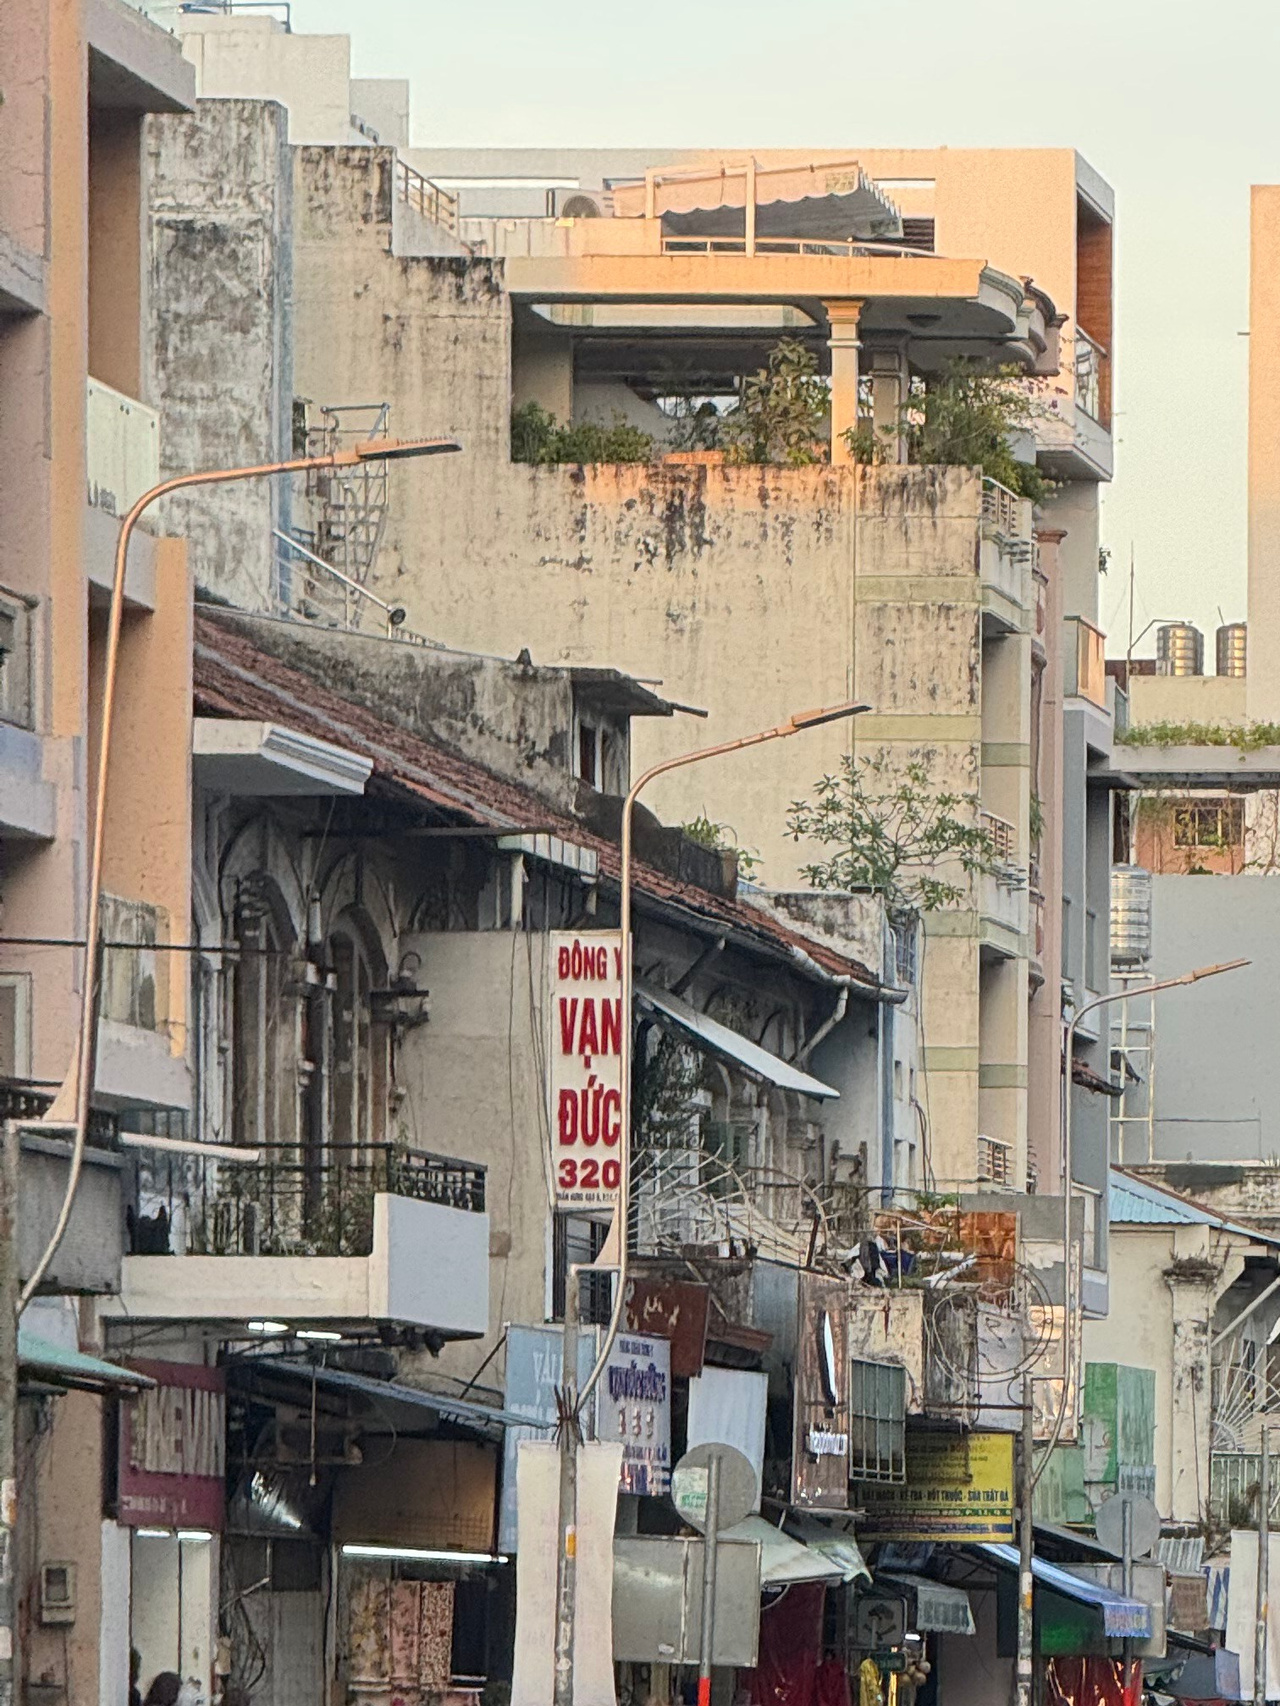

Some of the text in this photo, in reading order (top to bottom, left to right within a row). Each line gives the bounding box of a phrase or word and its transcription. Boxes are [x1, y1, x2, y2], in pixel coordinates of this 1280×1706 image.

[558, 939, 607, 981] ĐÔNG
[558, 997, 621, 1069] VẠN
[558, 1075, 621, 1147] ĐỨC
[558, 1158, 621, 1189] 320
